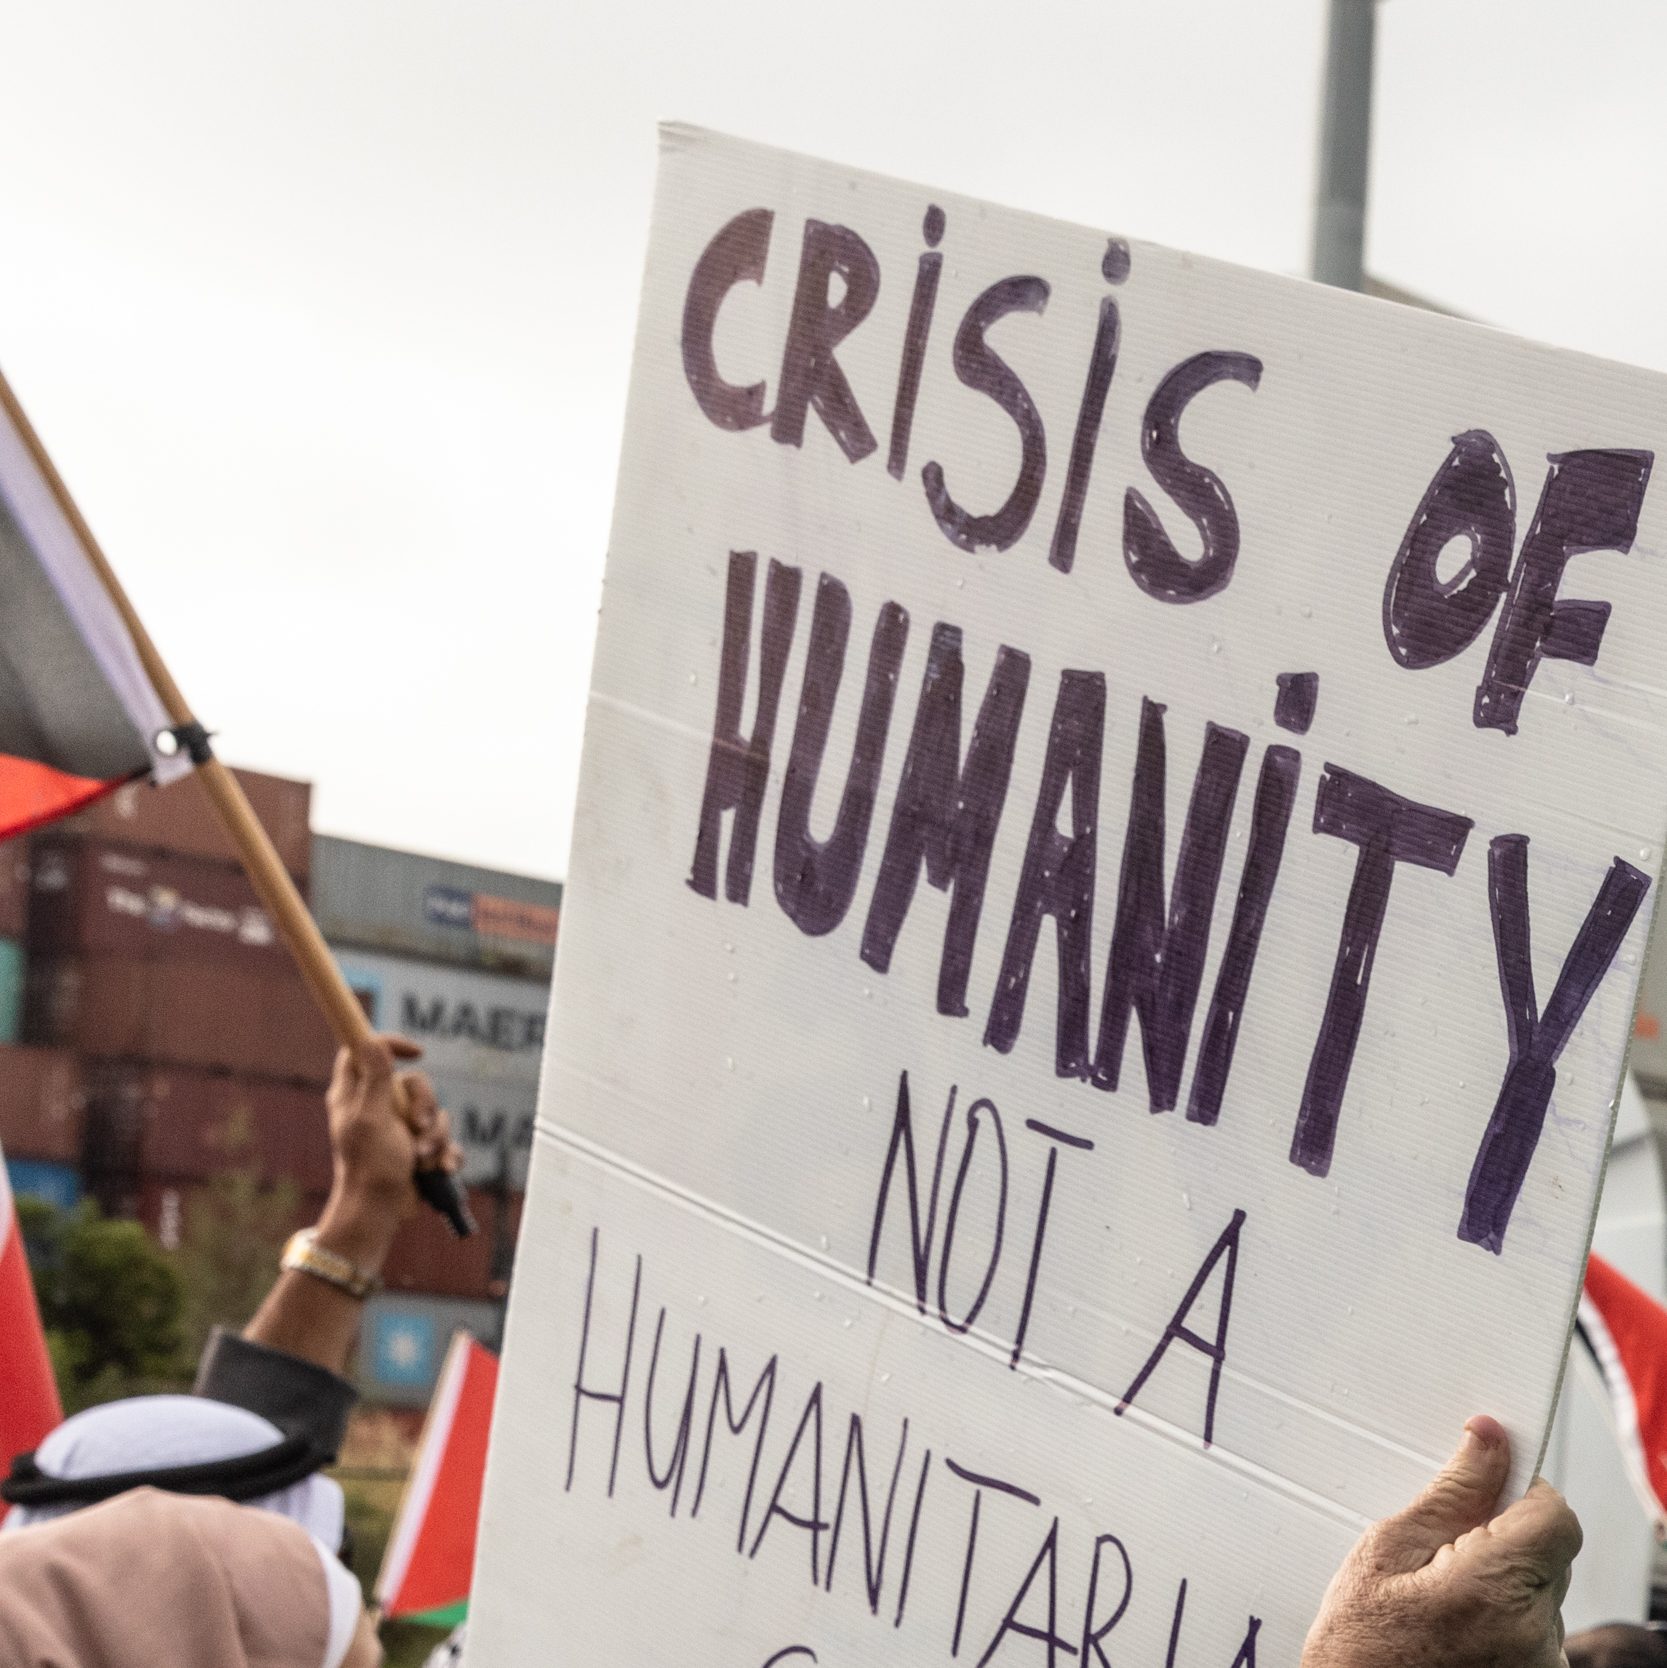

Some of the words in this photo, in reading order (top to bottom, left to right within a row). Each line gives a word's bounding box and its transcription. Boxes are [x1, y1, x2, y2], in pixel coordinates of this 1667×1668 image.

[680, 203, 1264, 605] CRISIS
[1382, 428, 1654, 736] OF
[685, 549, 1653, 1254] HUMANITY
[866, 1069, 1095, 1370] NOT
[1113, 1207, 1248, 1449] A
